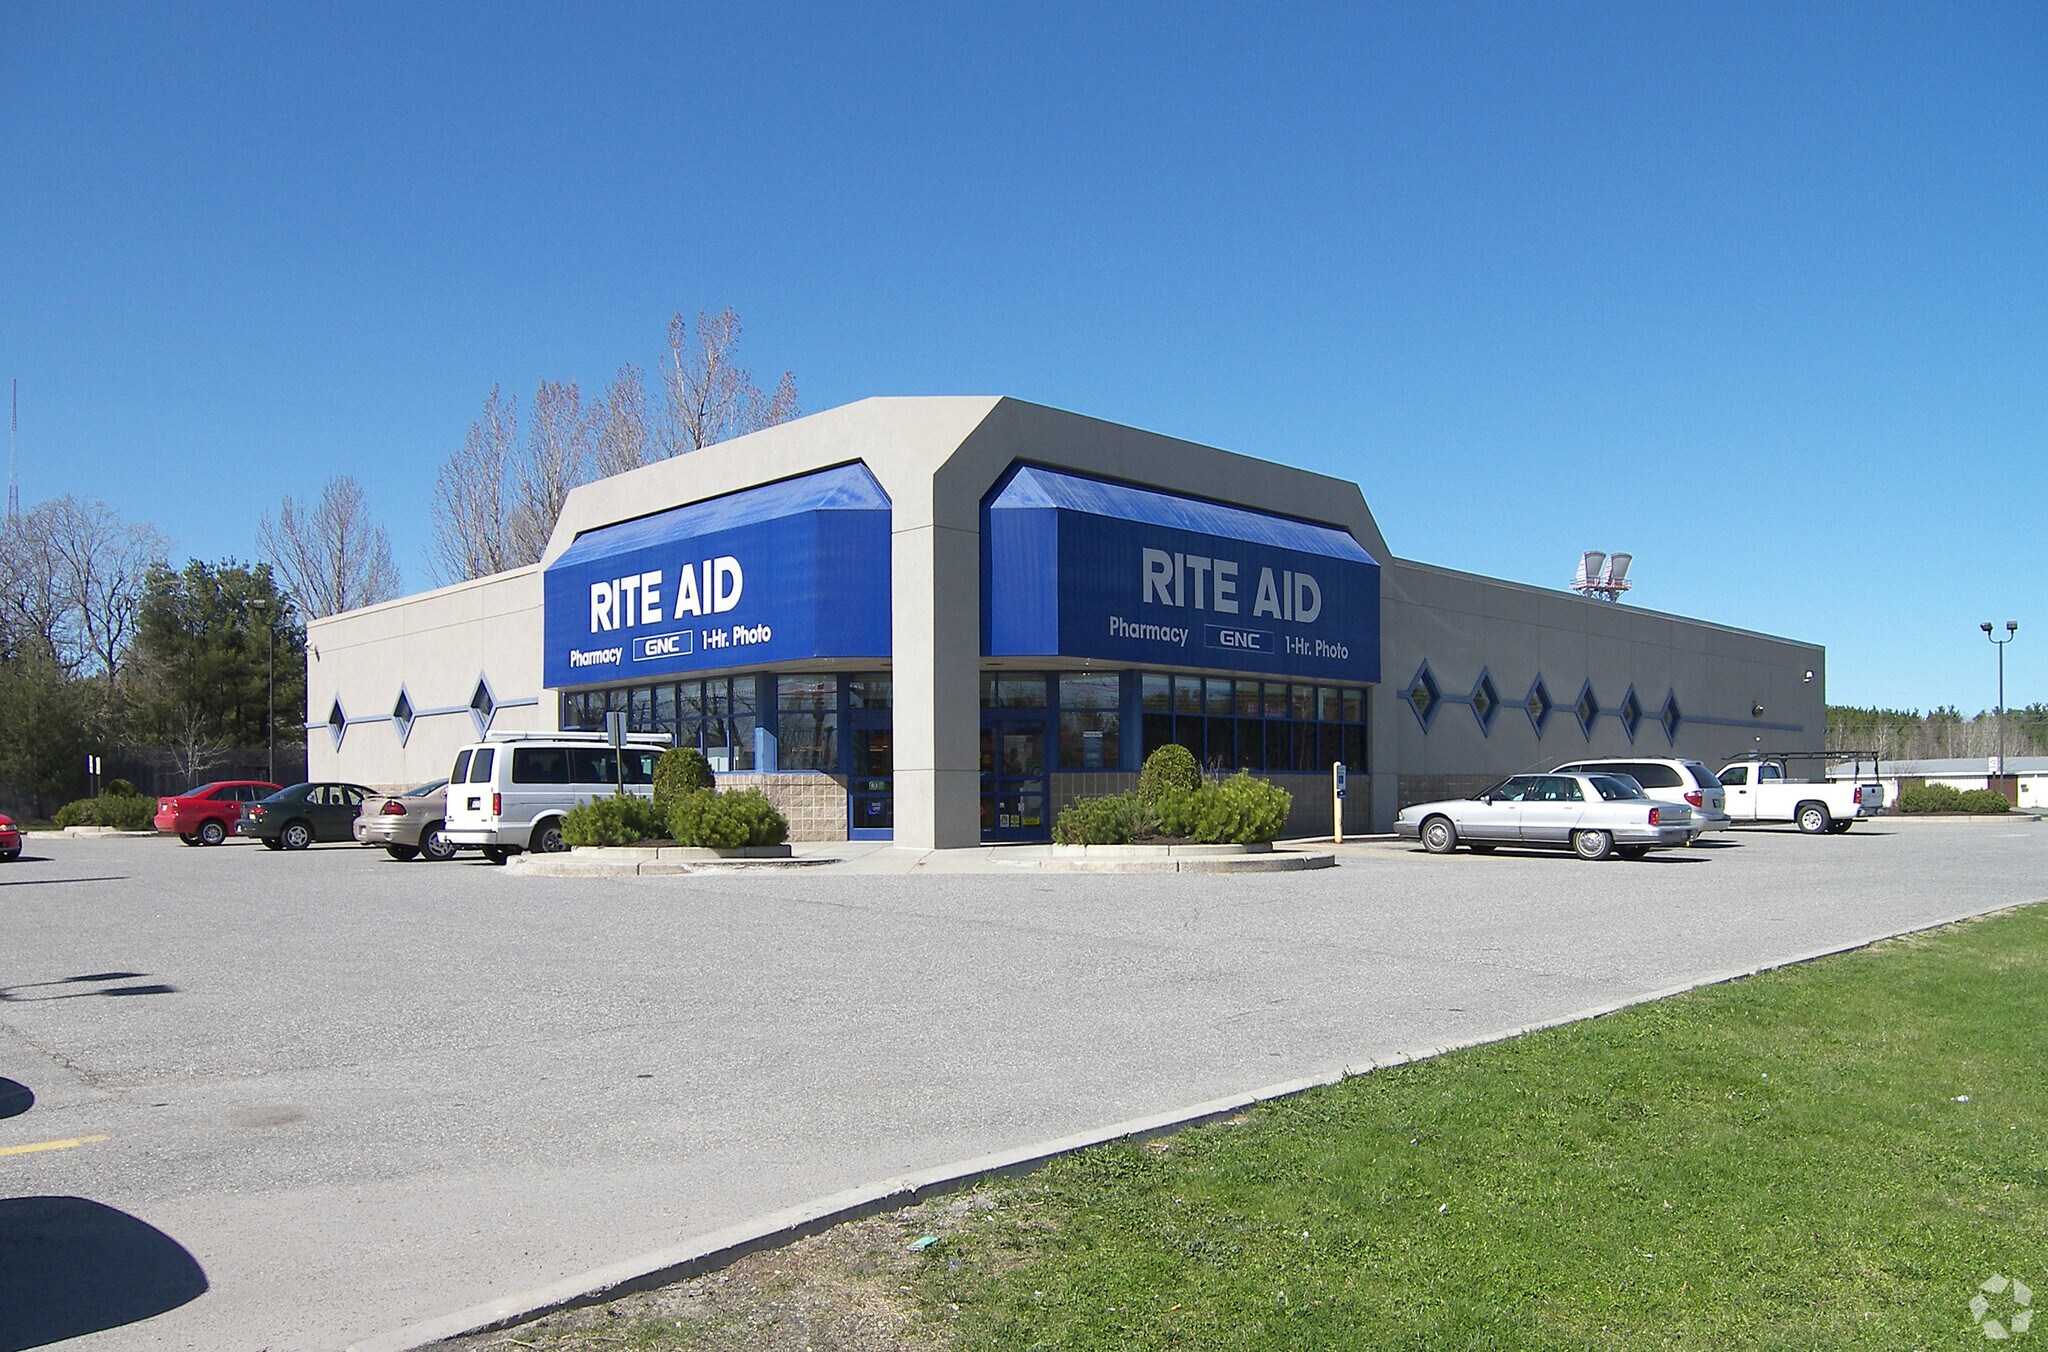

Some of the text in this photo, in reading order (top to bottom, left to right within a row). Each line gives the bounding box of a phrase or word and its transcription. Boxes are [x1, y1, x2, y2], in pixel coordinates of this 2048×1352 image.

[591, 555, 743, 634] RITE AID
[1142, 547, 1322, 624] RITE AID
[570, 623, 772, 668] Pharmacy GNC 1-Hr. Photo
[1109, 616, 1349, 660] Pharmacy GNC 1-Hr. Photo
